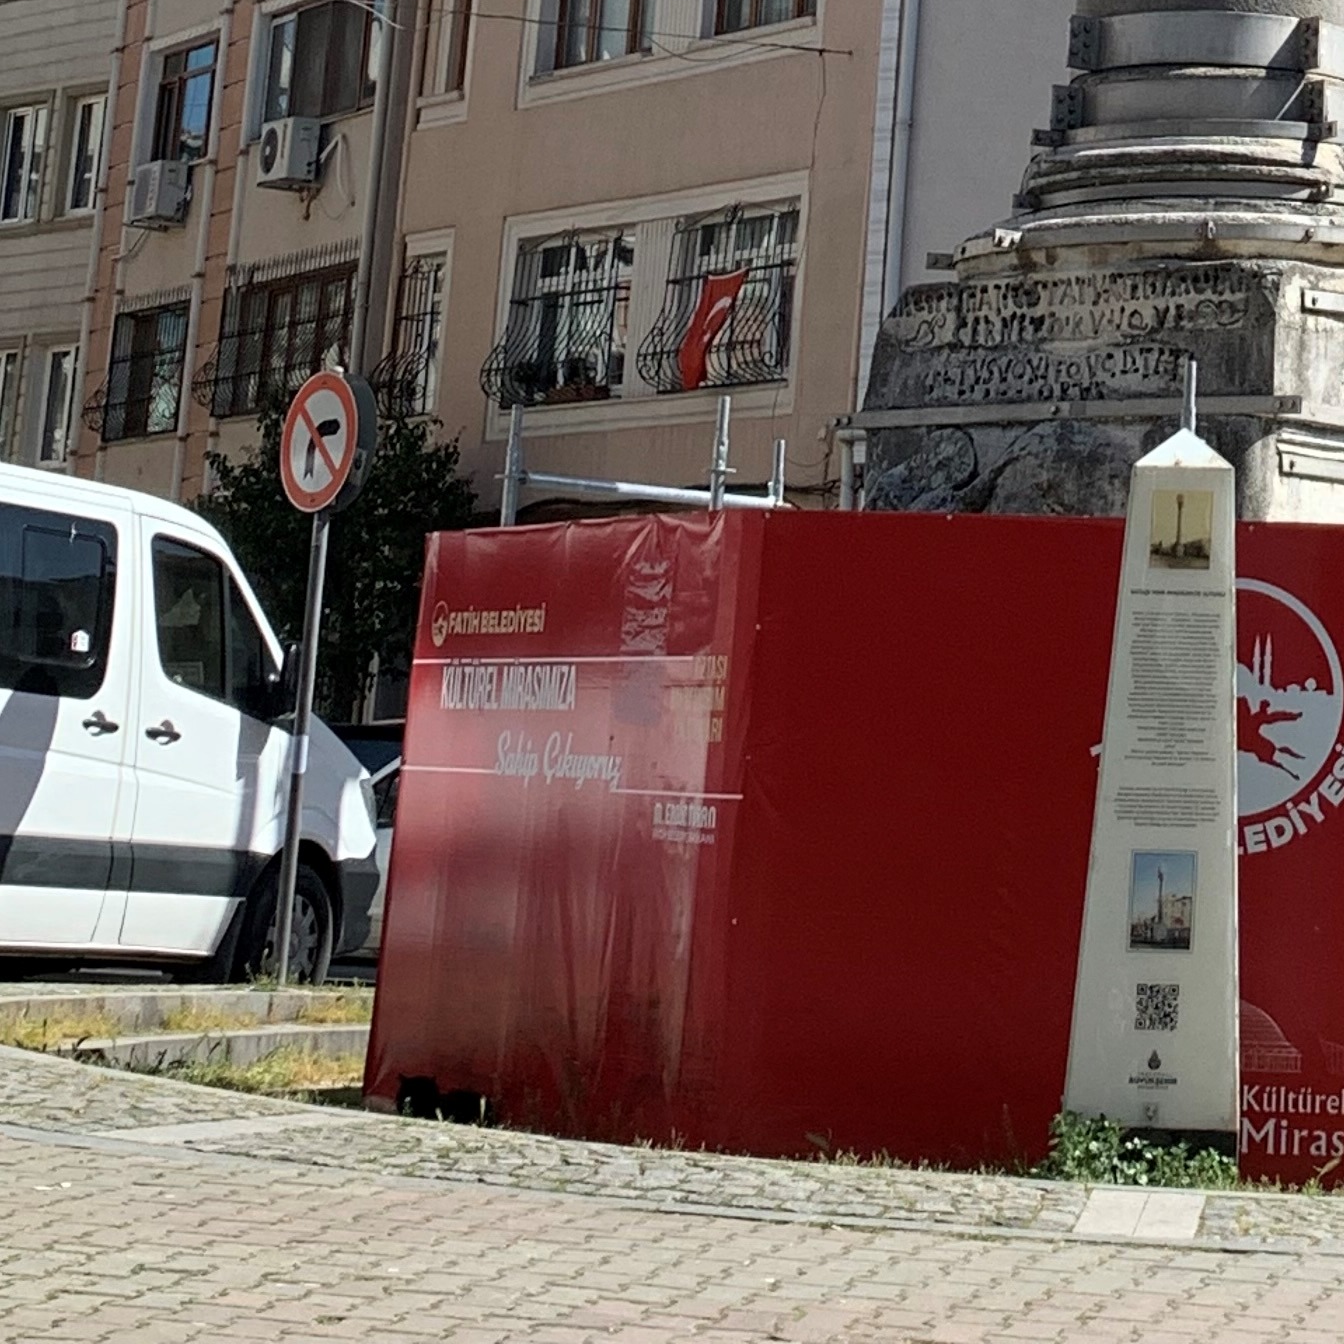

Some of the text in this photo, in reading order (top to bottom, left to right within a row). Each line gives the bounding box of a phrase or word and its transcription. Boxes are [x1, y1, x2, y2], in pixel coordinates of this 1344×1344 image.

[448, 603, 546, 634] FATİH BELEDİYESİ
[440, 658, 577, 710] KÜLTÜREL MİRASIMIZA
[495, 730, 539, 787] Sahip
